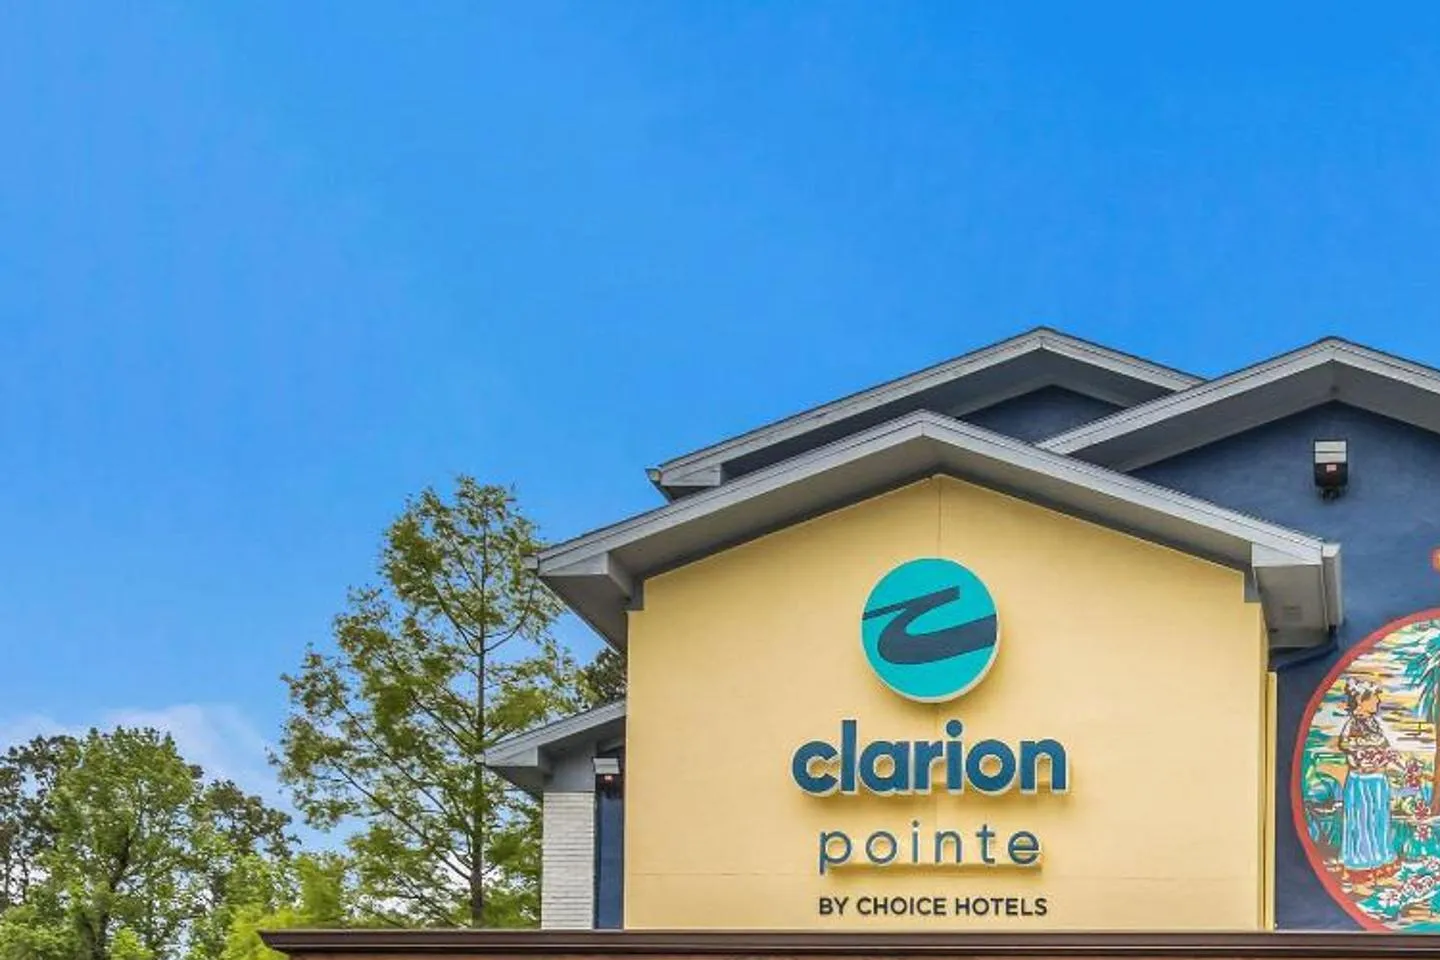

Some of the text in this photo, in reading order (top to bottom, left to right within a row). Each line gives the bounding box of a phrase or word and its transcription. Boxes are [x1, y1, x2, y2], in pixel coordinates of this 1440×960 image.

[792, 719, 1067, 794] clarion
[818, 820, 1040, 875] pointe
[819, 896, 1048, 916] BY CHOICE HOTELS
